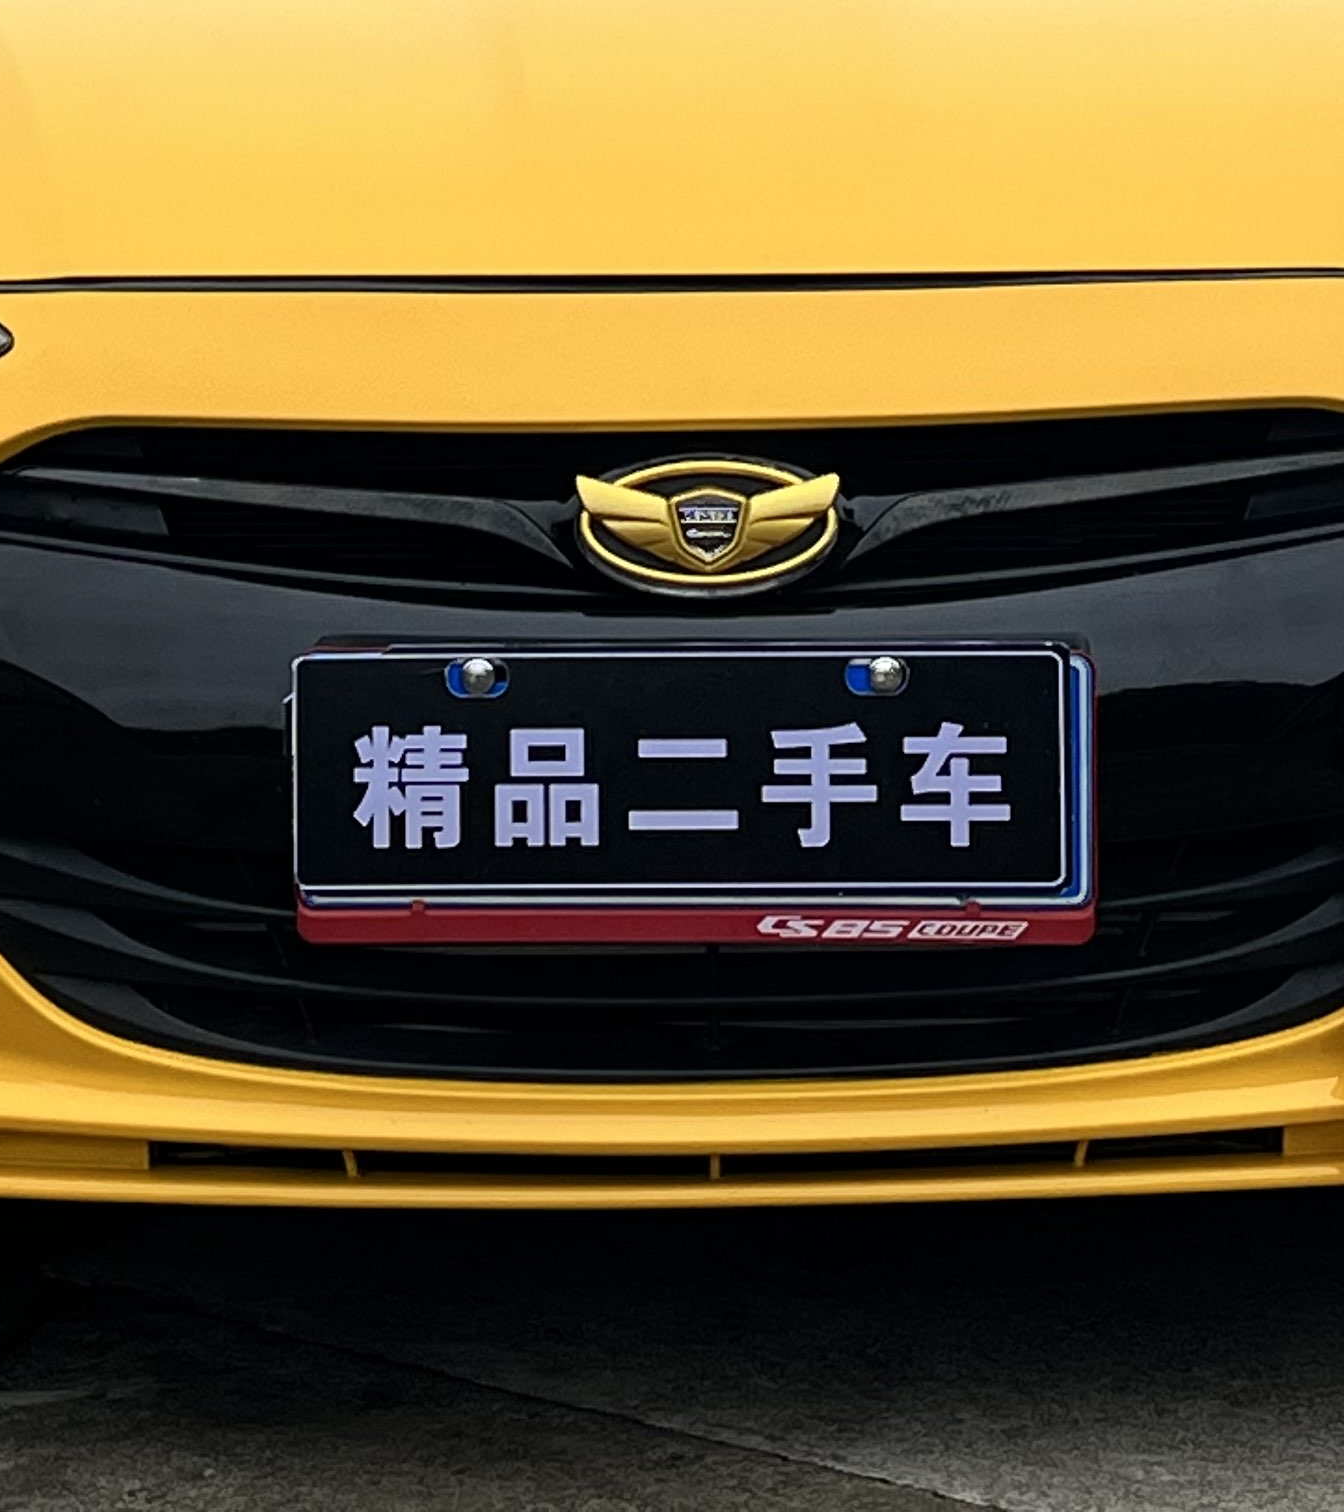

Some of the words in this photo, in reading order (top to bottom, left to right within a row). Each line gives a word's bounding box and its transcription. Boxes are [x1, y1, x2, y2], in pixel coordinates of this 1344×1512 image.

[353, 722, 1010, 849] 精品二手车
[913, 920, 1022, 938] COUPE
